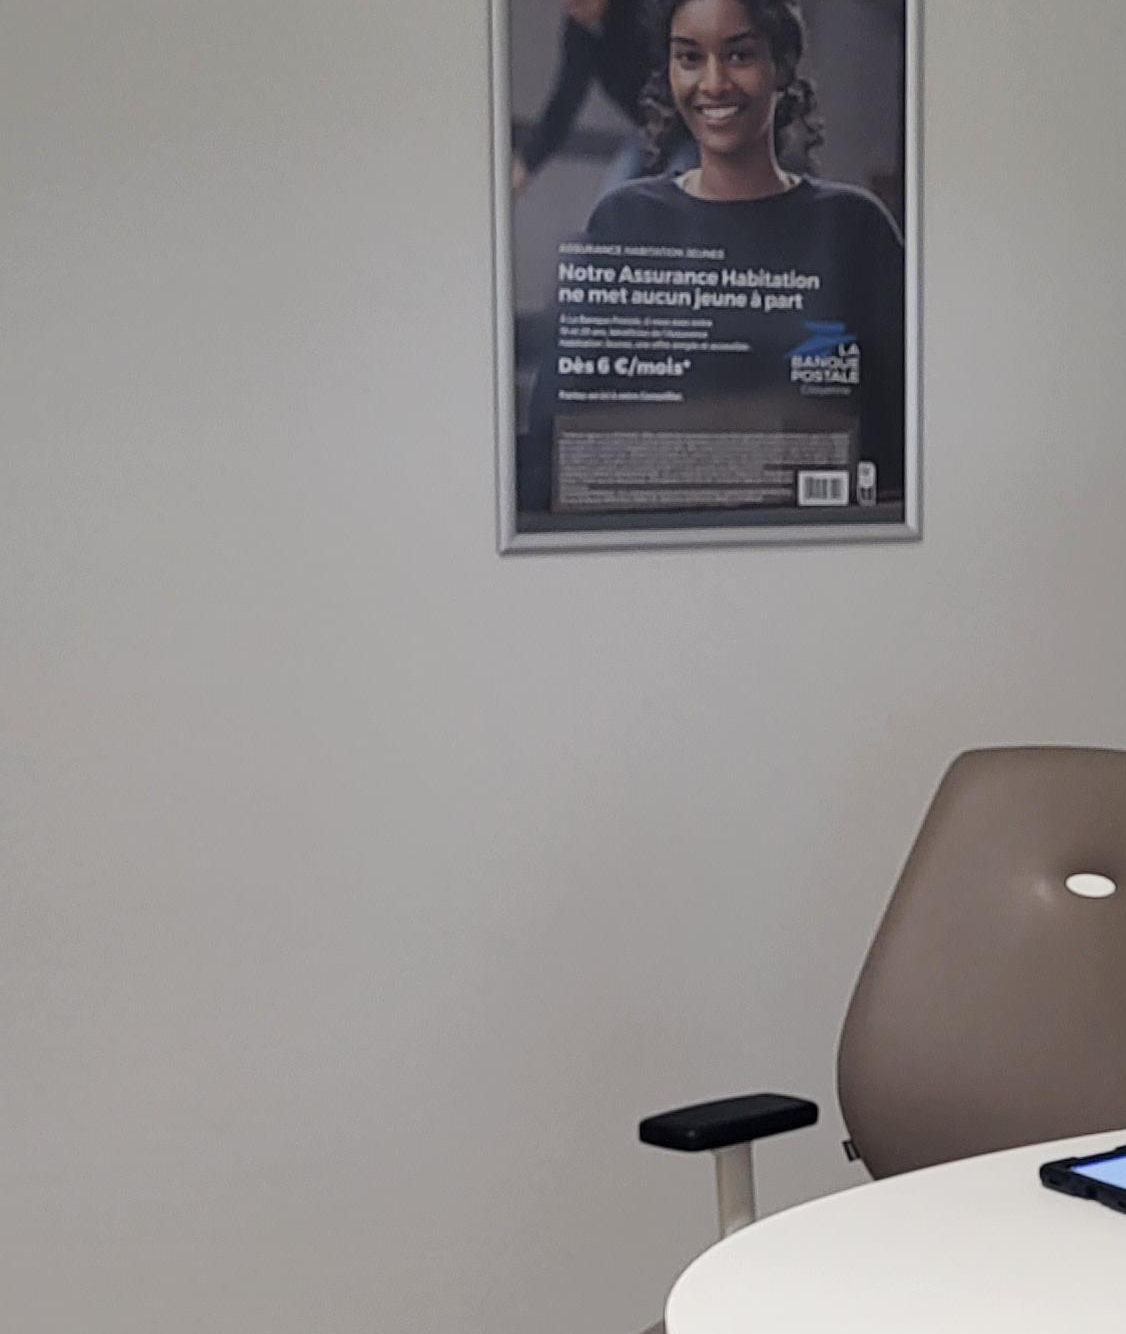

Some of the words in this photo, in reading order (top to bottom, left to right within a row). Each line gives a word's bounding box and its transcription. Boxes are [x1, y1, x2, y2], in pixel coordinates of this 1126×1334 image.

[559, 263, 616, 283] Notre
[618, 265, 719, 285] Assurance
[721, 268, 820, 290] Habitation
[559, 288, 585, 303] ne
[587, 288, 627, 304] met
[631, 290, 692, 306] aucun
[692, 287, 748, 310] jeune
[750, 289, 762, 308] à
[764, 293, 803, 312] part
[838, 343, 860, 356] LA
[559, 355, 595, 375] Dès
[597, 356, 610, 375] 6
[791, 355, 860, 369] BANQUE
[791, 369, 860, 384] POSTALE
